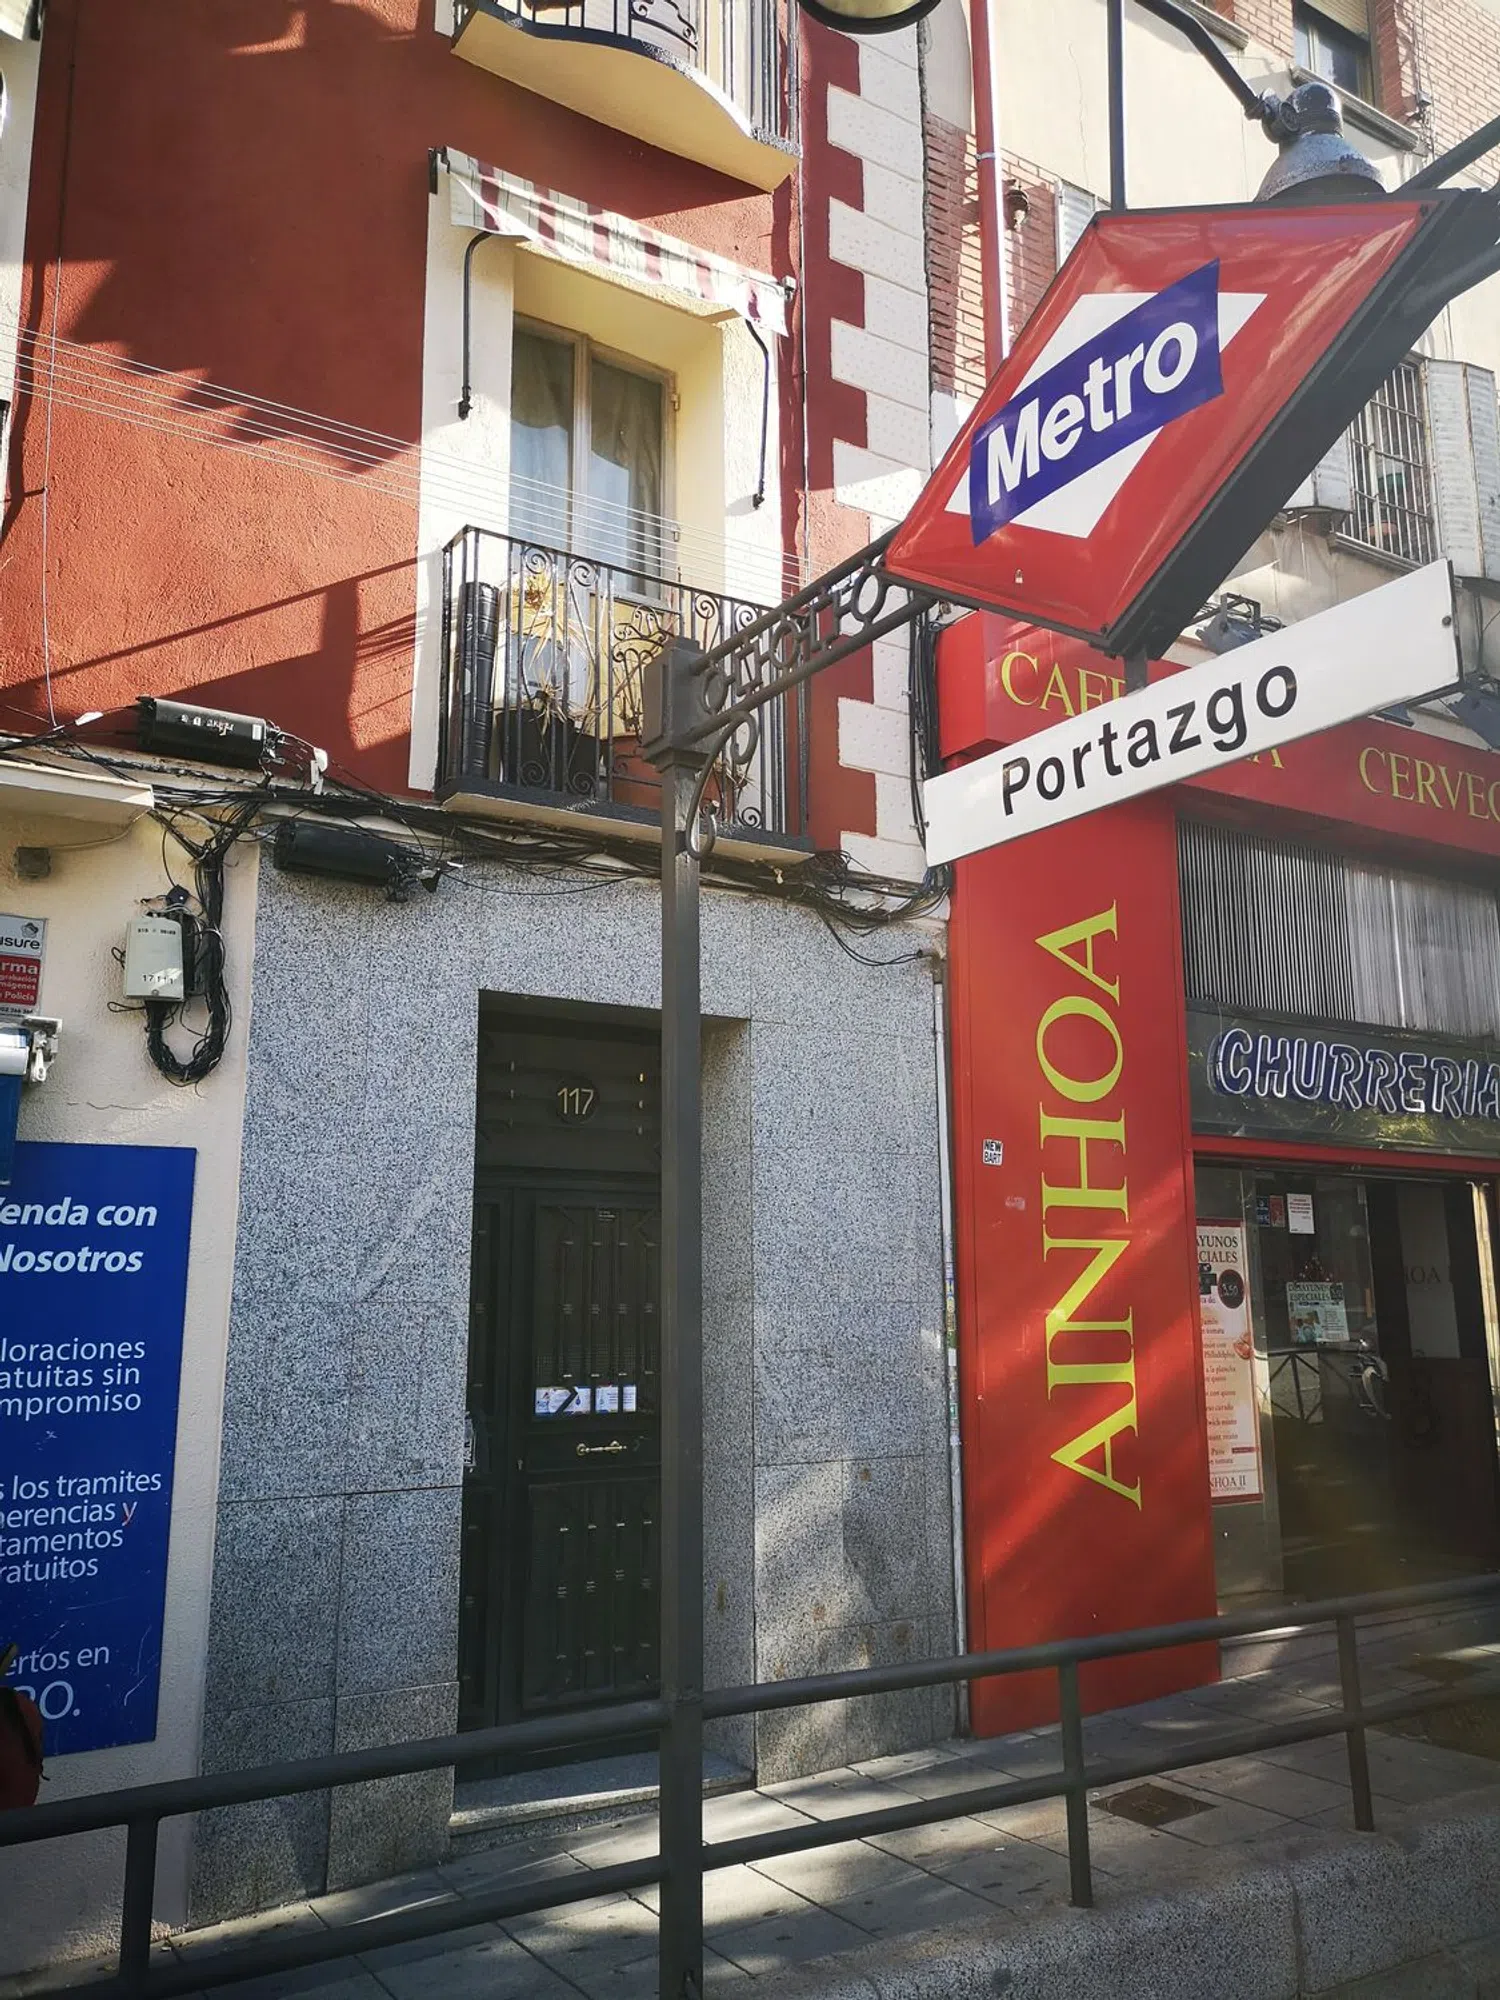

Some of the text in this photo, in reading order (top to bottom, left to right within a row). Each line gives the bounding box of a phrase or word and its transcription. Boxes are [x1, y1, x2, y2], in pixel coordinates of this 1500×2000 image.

[987, 320, 1199, 506] Metro
[1001, 665, 1298, 815] Portazgo
[1212, 1028, 1500, 1120] CHURRERIA
[557, 1088, 595, 1115] 117
[0, 1196, 158, 1227] enda con
[1034, 899, 1142, 1511] AINHOA
[0, 1337, 146, 1363] loraciones
[0, 1362, 141, 1390] atuitas sin
[12, 1475, 50, 1500] los
[56, 1470, 162, 1498] tramites
[121, 1501, 138, 1527] y
[76, 1646, 110, 1667] en
